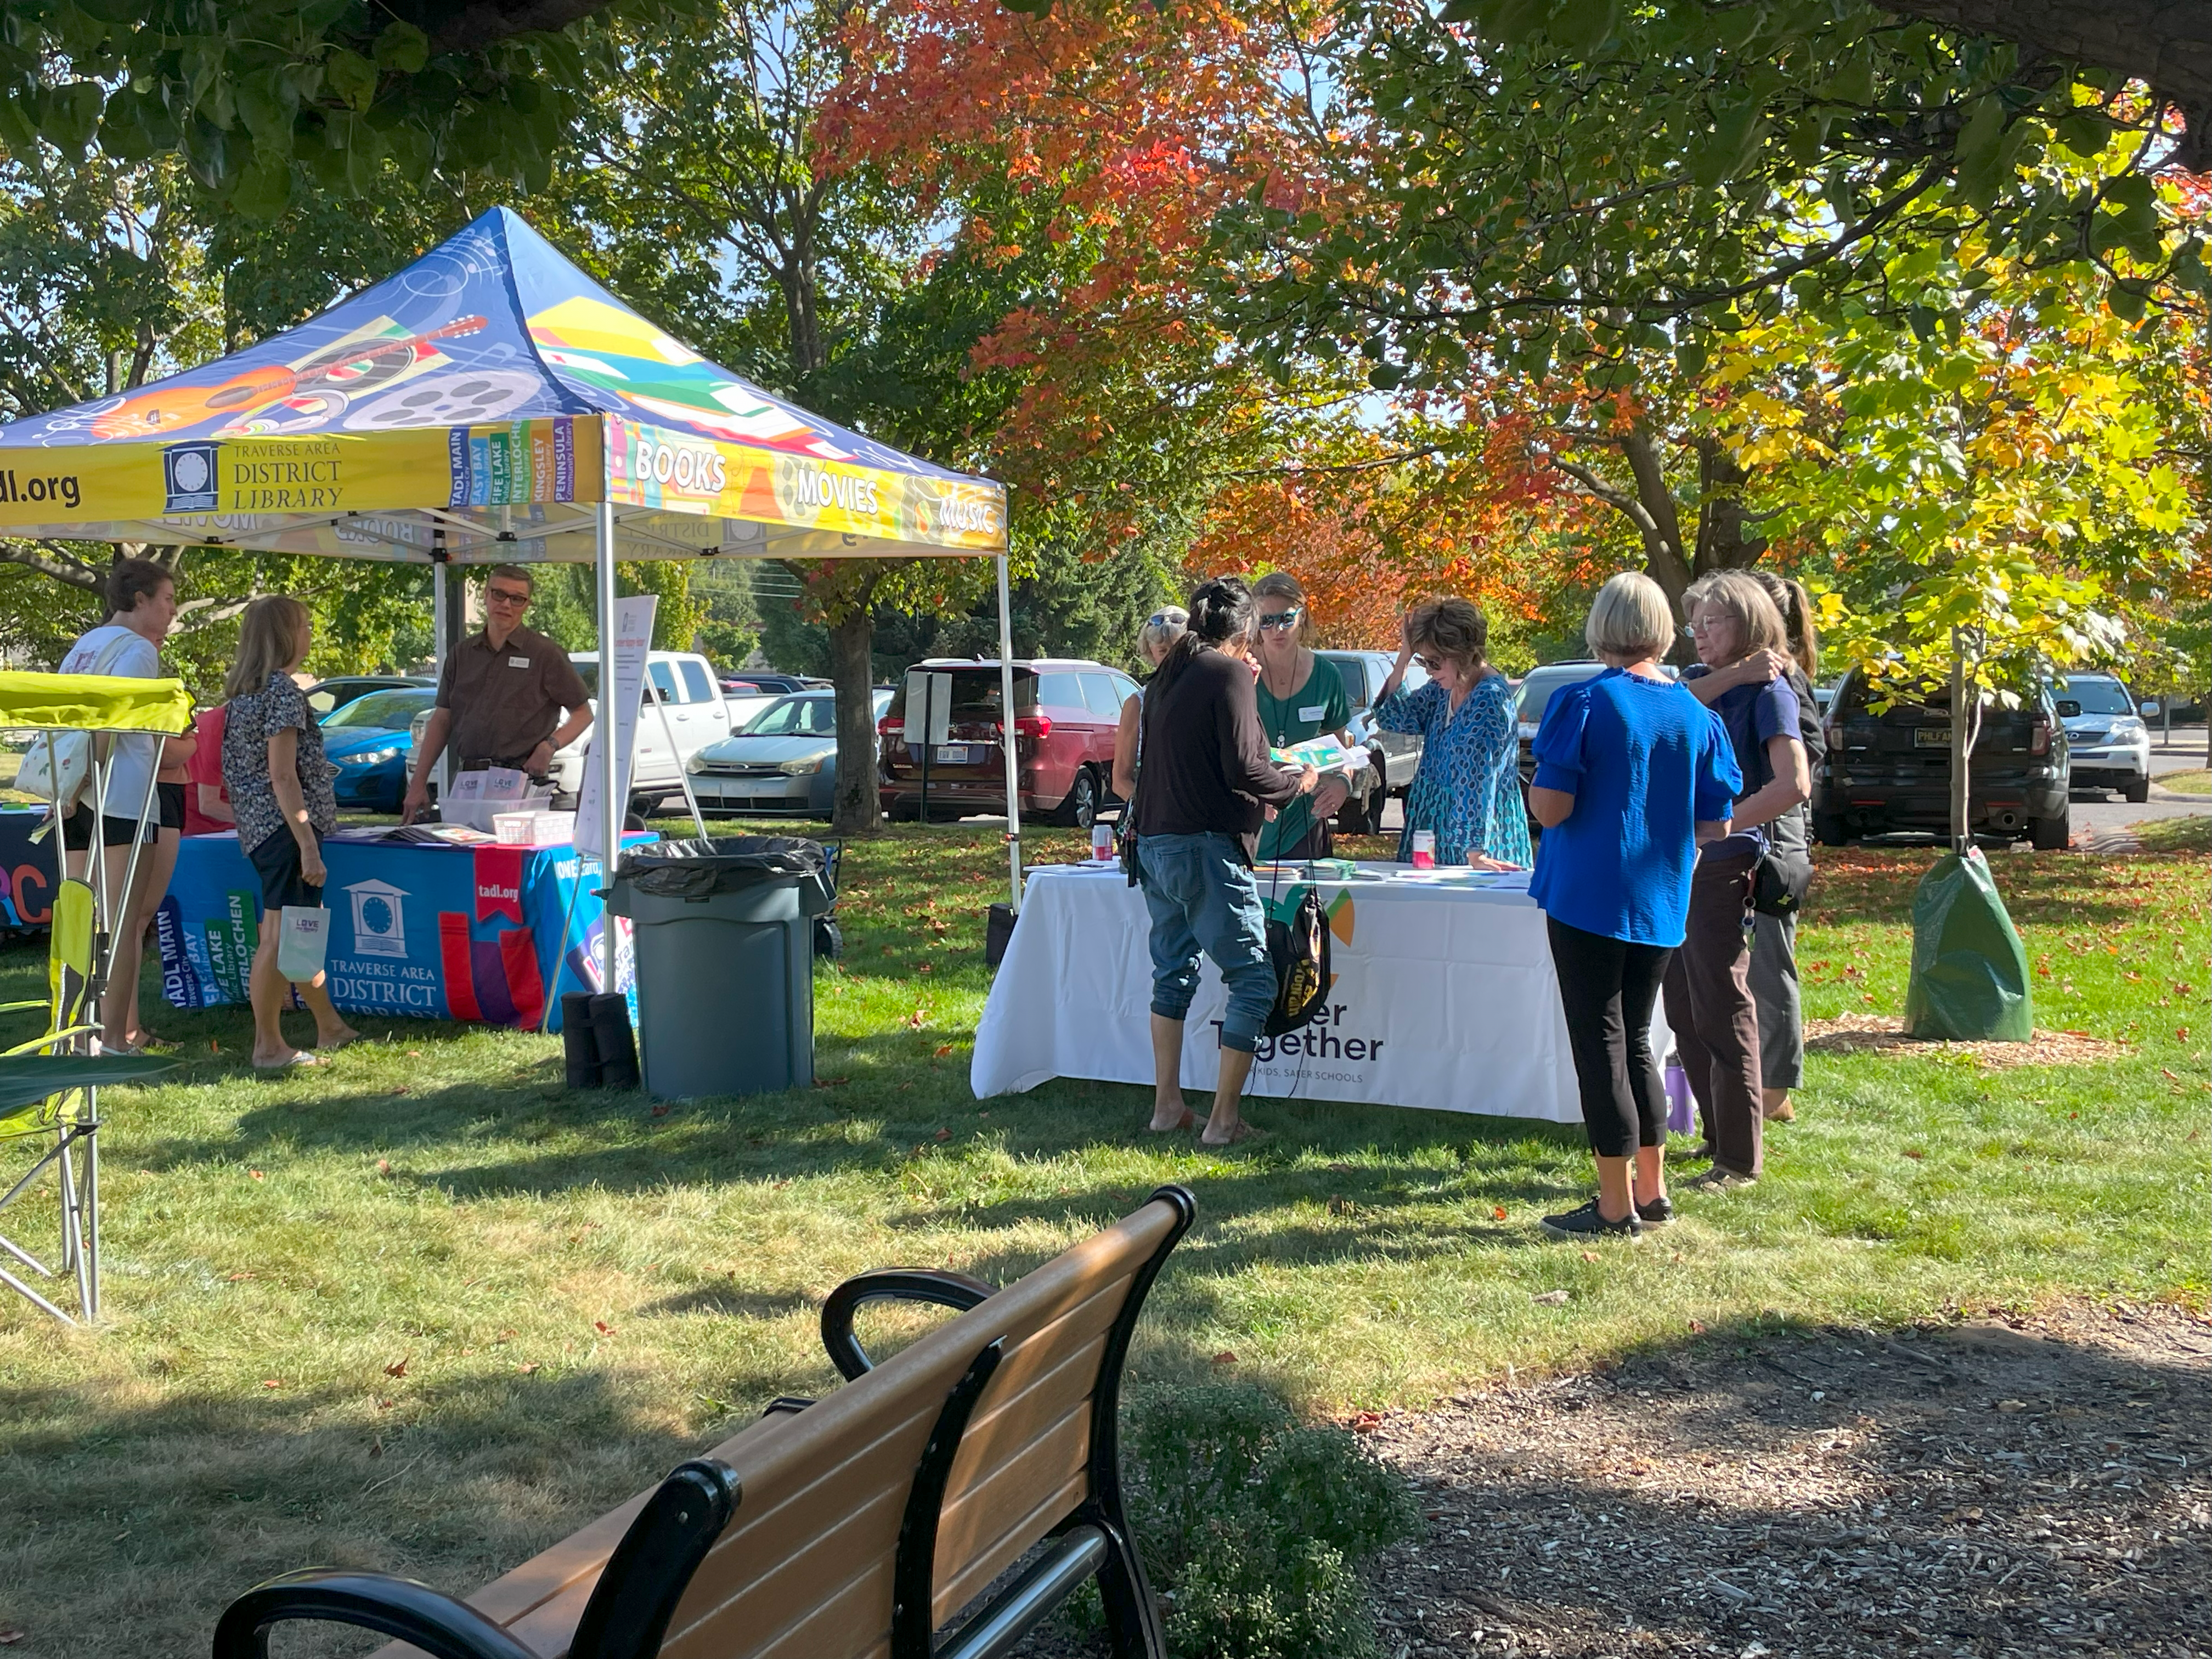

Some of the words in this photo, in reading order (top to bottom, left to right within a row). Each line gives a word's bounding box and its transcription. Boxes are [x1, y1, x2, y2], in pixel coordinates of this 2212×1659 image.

[234, 444, 299, 458] TRAVERSE
[305, 443, 341, 455] AREA
[451, 432, 463, 469] MAIN
[566, 422, 574, 451] Library
[234, 460, 342, 484] DISTRICT
[472, 445, 482, 471] BAY
[492, 441, 503, 476] LAKE
[522, 448, 531, 476] Library
[534, 438, 545, 502] KINGSLEY
[555, 426, 566, 501] PENINSULA
[635, 440, 726, 492] BOOKS
[451, 472, 464, 507] TADL
[471, 473, 483, 504] EAST
[492, 478, 503, 504] FIFE
[502, 478, 510, 504] Public
[566, 453, 574, 501] Community
[798, 468, 878, 515] MOVIES
[234, 488, 343, 509] LIBRARY
[939, 496, 994, 534] MUSIC
[558, 859, 578, 879] ONE
[478, 884, 518, 902] tadl.org
[157, 911, 178, 961] MAIN
[296, 919, 319, 928] LOVE
[184, 930, 200, 963] BAY
[209, 930, 226, 974] LAKE
[225, 943, 236, 980] Library
[182, 955, 191, 973] City
[331, 960, 397, 977] TRAVERSE
[401, 967, 435, 981] AREA
[185, 973, 198, 1008] Traverse
[332, 978, 436, 1007] DISTRICT
[1210, 1020, 1384, 1063] Tgether
[1258, 1067, 1282, 1077] KIDS,
[1316, 1071, 1363, 1083] SCHOOLS
